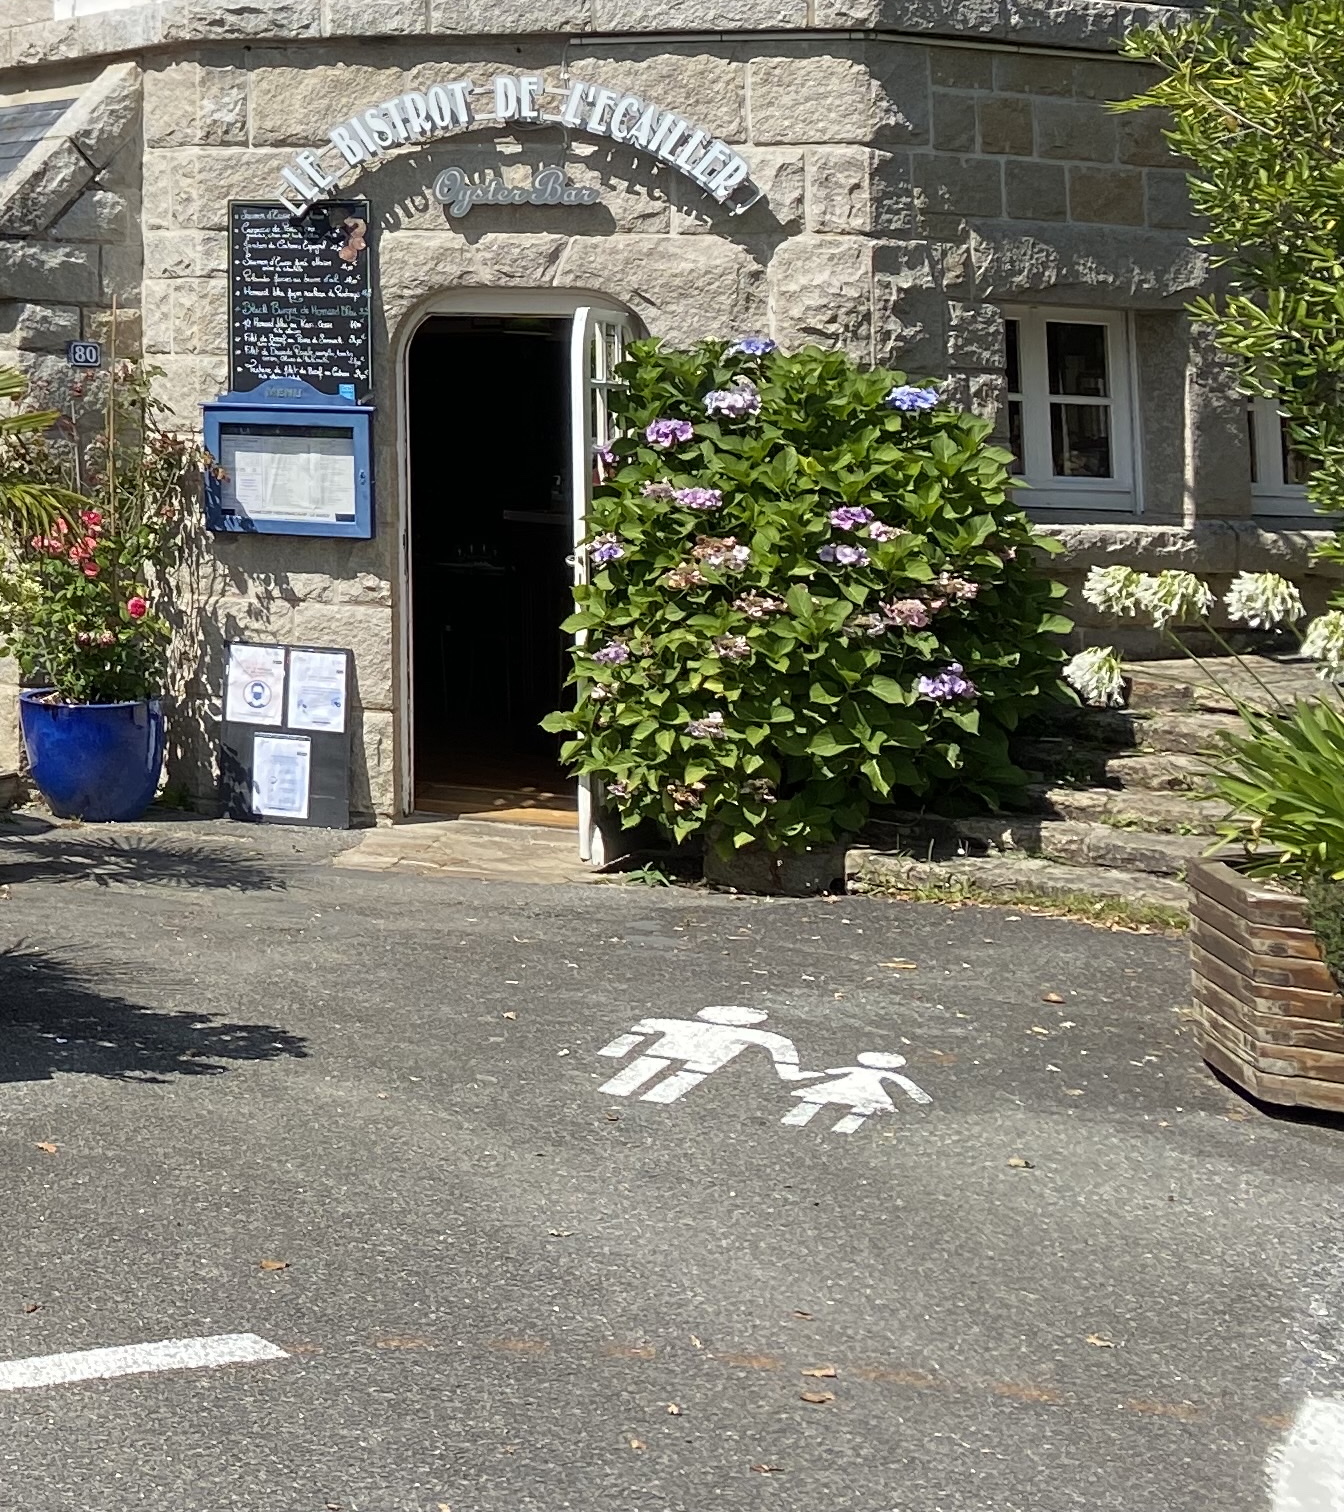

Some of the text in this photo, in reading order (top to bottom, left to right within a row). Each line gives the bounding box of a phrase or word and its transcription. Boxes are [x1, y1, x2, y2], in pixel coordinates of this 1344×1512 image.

[280, 75, 751, 201] LE BISTROT DE L'ECAILLER
[434, 167, 599, 216] Oyster Bar
[75, 346, 97, 363] 80
[265, 387, 303, 399] MENU
